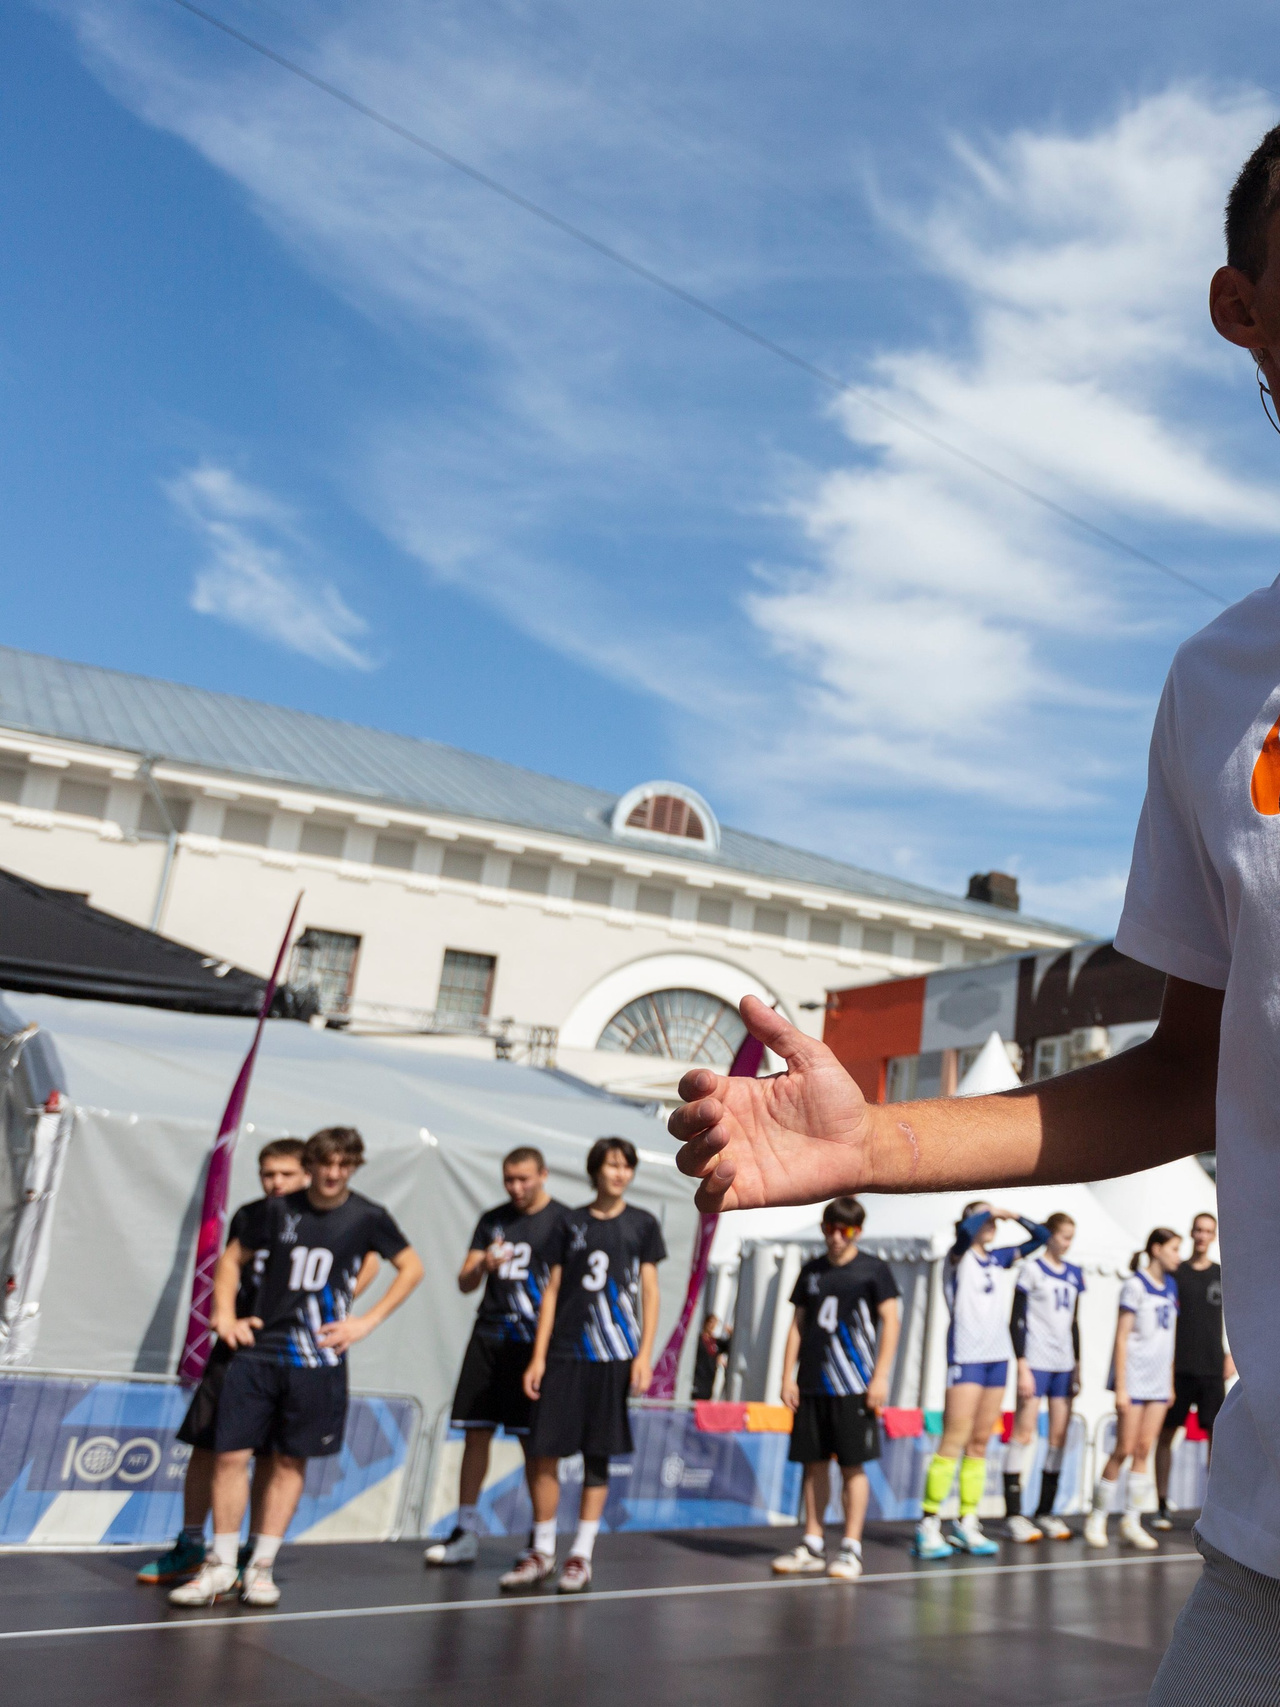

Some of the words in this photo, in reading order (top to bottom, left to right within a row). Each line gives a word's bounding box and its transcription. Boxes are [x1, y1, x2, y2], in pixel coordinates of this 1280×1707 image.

[288, 1246, 334, 1291] 10
[582, 1250, 609, 1291] 3
[818, 1295, 838, 1333] 4
[61, 1435, 162, 1483] 100
